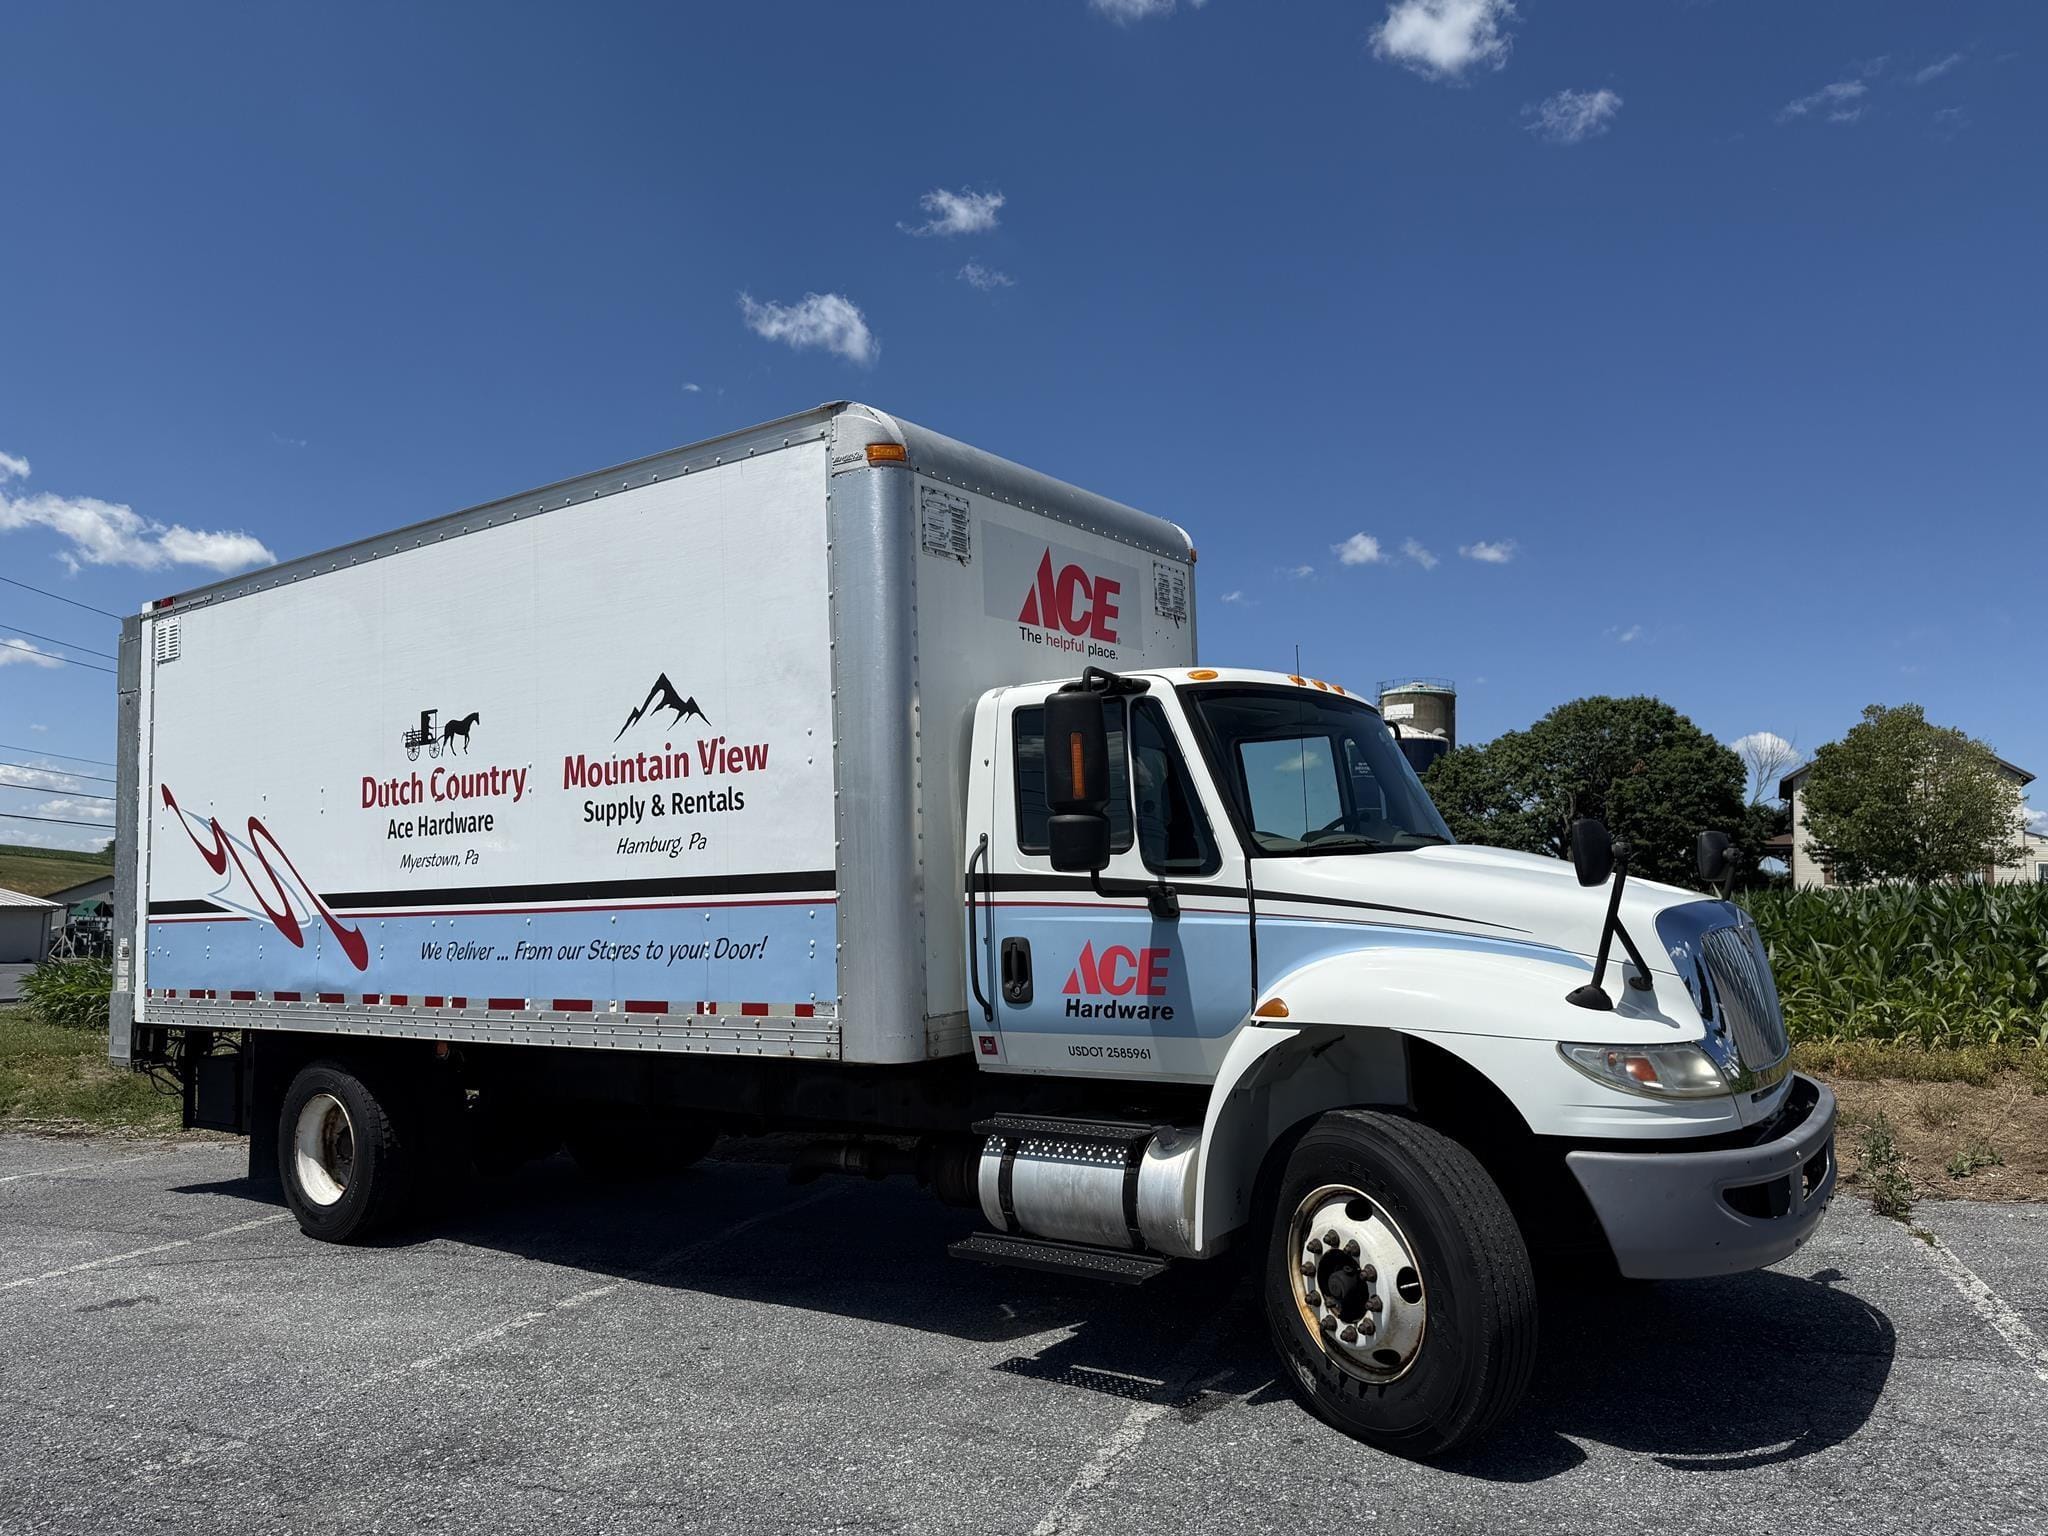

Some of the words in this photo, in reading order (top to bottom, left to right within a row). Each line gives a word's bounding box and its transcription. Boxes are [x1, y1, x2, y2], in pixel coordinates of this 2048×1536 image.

[1018, 545, 1120, 645] ACE
[1019, 626, 1042, 644] The
[1046, 632, 1085, 653] helpful
[1088, 643, 1119, 660] place.
[563, 742, 690, 790] Mountain
[697, 735, 769, 775] View
[361, 771, 424, 809] Dutch
[430, 765, 527, 803] Country
[583, 794, 646, 827] Supply
[651, 793, 666, 817] &
[671, 785, 745, 815] Rentals
[387, 818, 414, 840] Ace
[418, 811, 494, 837] Hardware
[400, 853, 461, 874] Myerstown,
[464, 849, 480, 865] Pa
[616, 835, 683, 859] Hamburg,
[689, 832, 707, 850] Pa
[421, 941, 442, 961] We
[446, 940, 494, 961] Deliver
[514, 940, 552, 961] From
[557, 944, 584, 961] our
[587, 939, 640, 962] Stores
[646, 940, 663, 960] to
[667, 944, 709, 967] your
[714, 935, 768, 960] Door!
[1062, 939, 1171, 996] ACE
[1065, 998, 1175, 1021] Hardware
[1068, 1045, 1104, 1058] USDOT
[1106, 1047, 1152, 1060] 2585961
